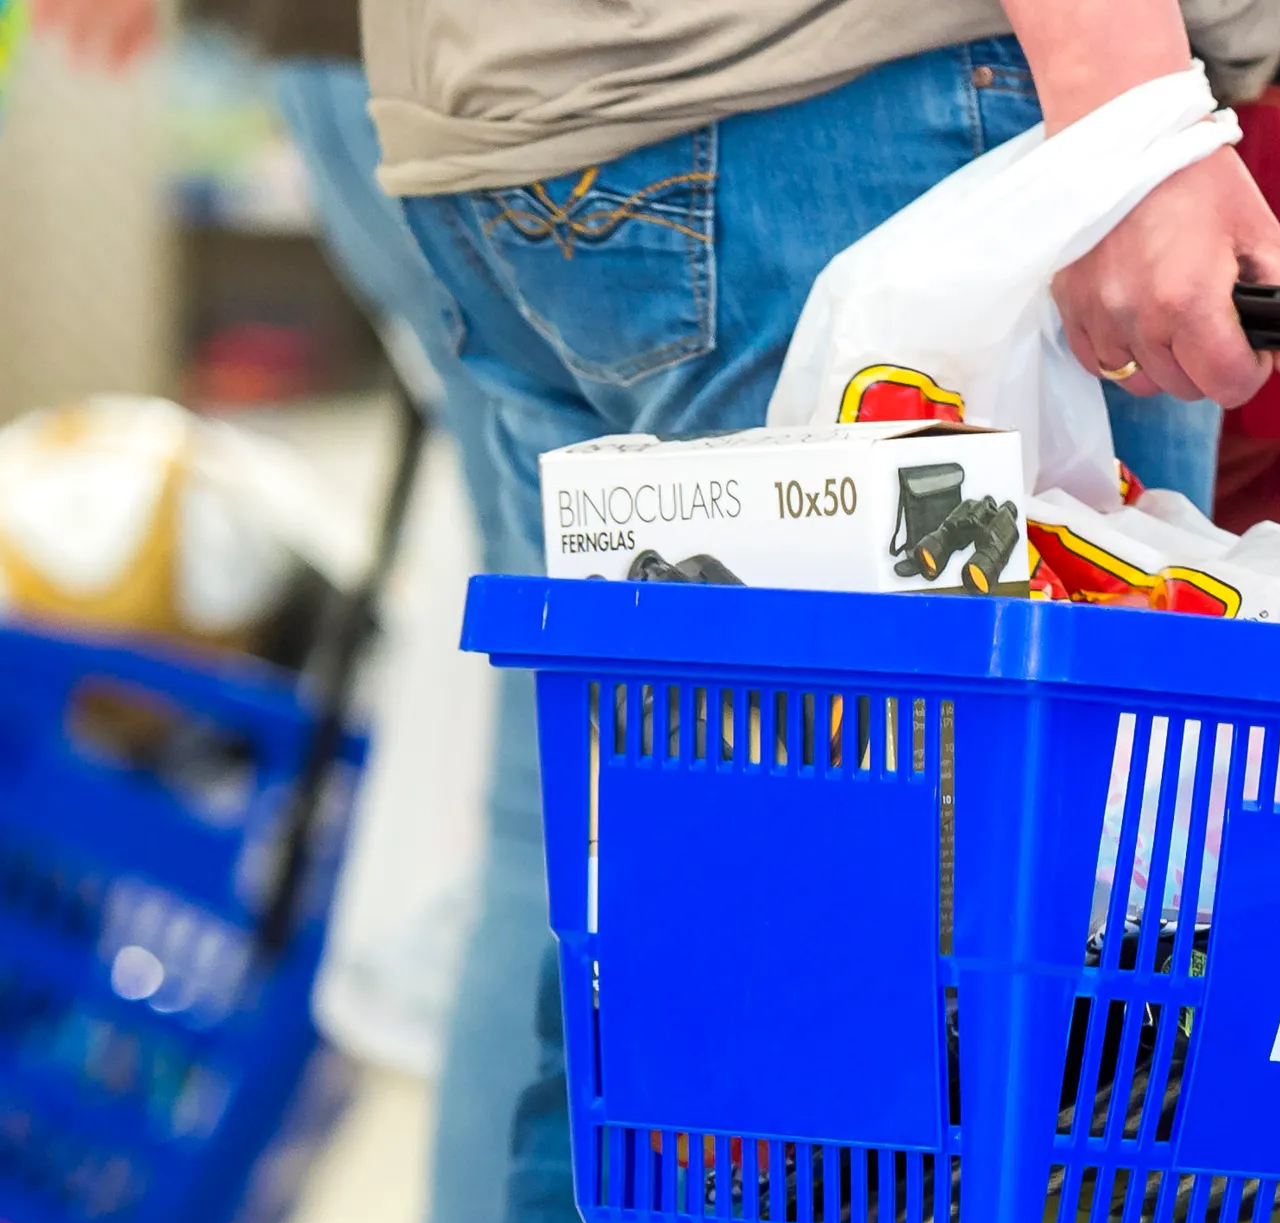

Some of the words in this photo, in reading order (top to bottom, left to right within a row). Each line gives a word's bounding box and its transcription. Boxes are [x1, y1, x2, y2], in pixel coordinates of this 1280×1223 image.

[558, 479, 742, 528] BINOCULARS
[774, 476, 858, 519] 10x50
[561, 530, 636, 554] FERNGLAS
